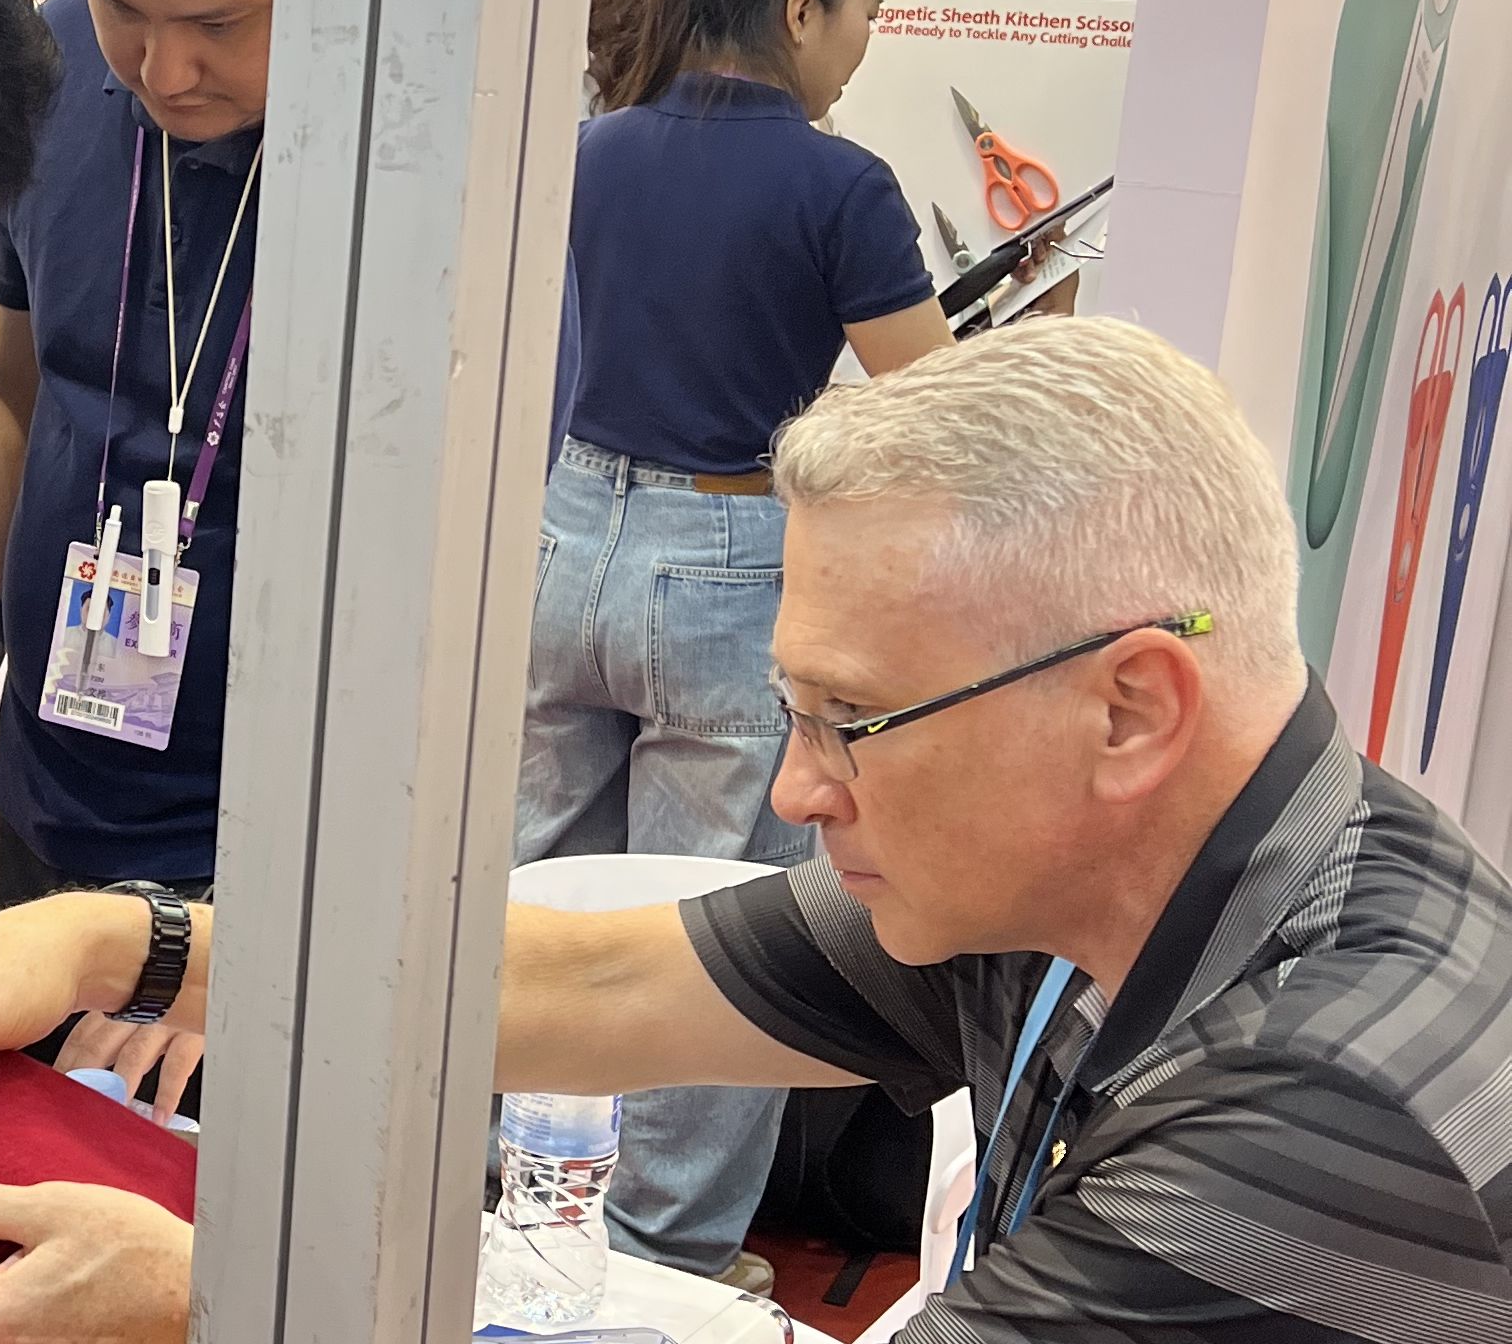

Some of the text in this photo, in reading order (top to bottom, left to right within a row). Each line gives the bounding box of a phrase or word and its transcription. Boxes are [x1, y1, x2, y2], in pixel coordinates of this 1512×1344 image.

[941, 7, 1000, 25] Sheath
[1005, 11, 1071, 29] Kitchen
[878, 24, 902, 35] and
[906, 24, 946, 40] Ready
[949, 27, 962, 38] to
[965, 27, 1008, 41] Tackle
[1011, 30, 1037, 45] Any
[1040, 32, 1088, 48] Cutting
